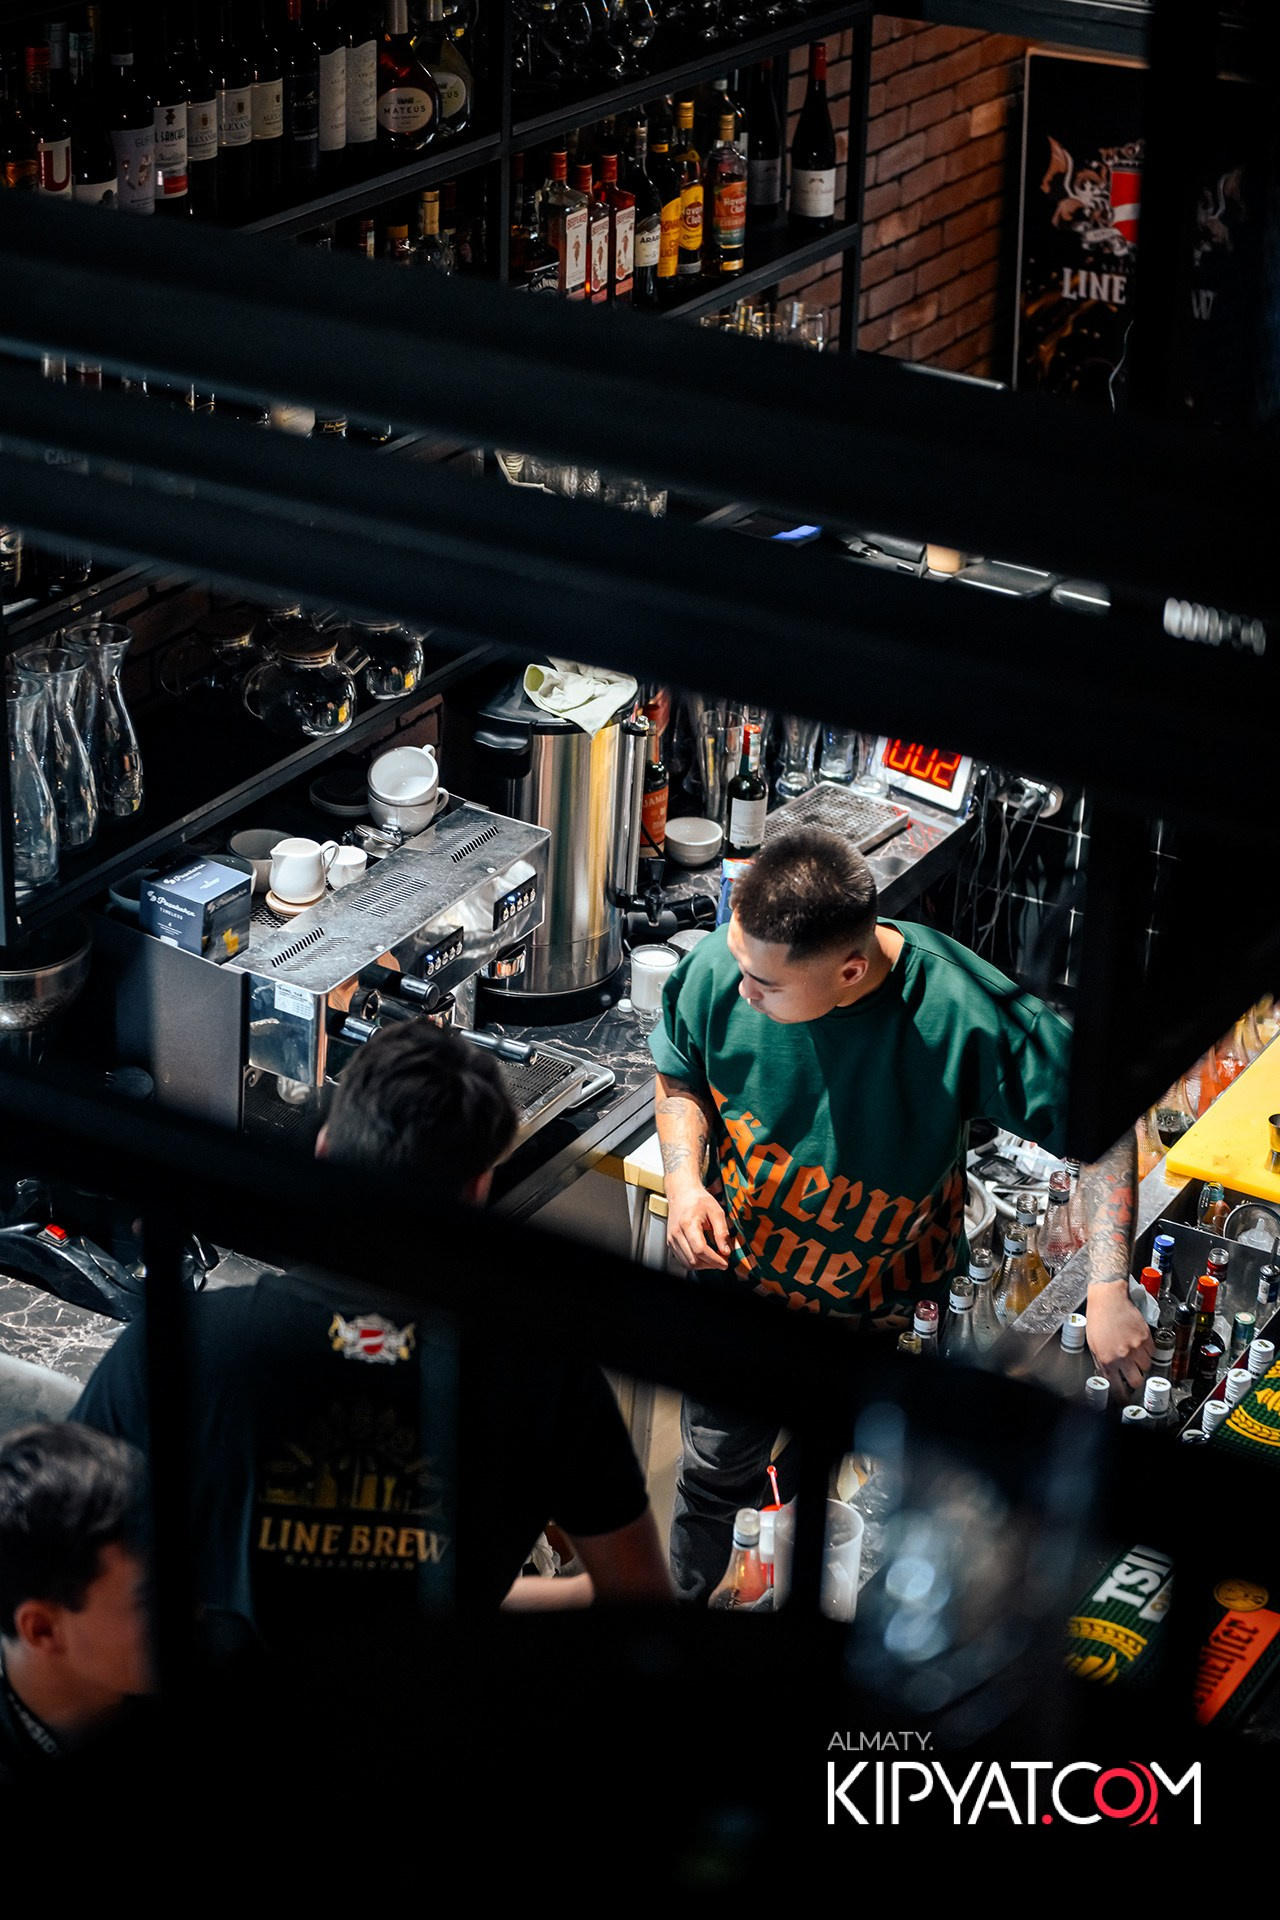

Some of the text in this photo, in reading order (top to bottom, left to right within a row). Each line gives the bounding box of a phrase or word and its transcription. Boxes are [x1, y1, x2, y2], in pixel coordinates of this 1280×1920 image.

[383, 105, 426, 114] MATEUS
[1061, 266, 1127, 305] LINE
[159, 907, 183, 920] TIMELESS
[258, 1516, 450, 1565] LINE BREW
